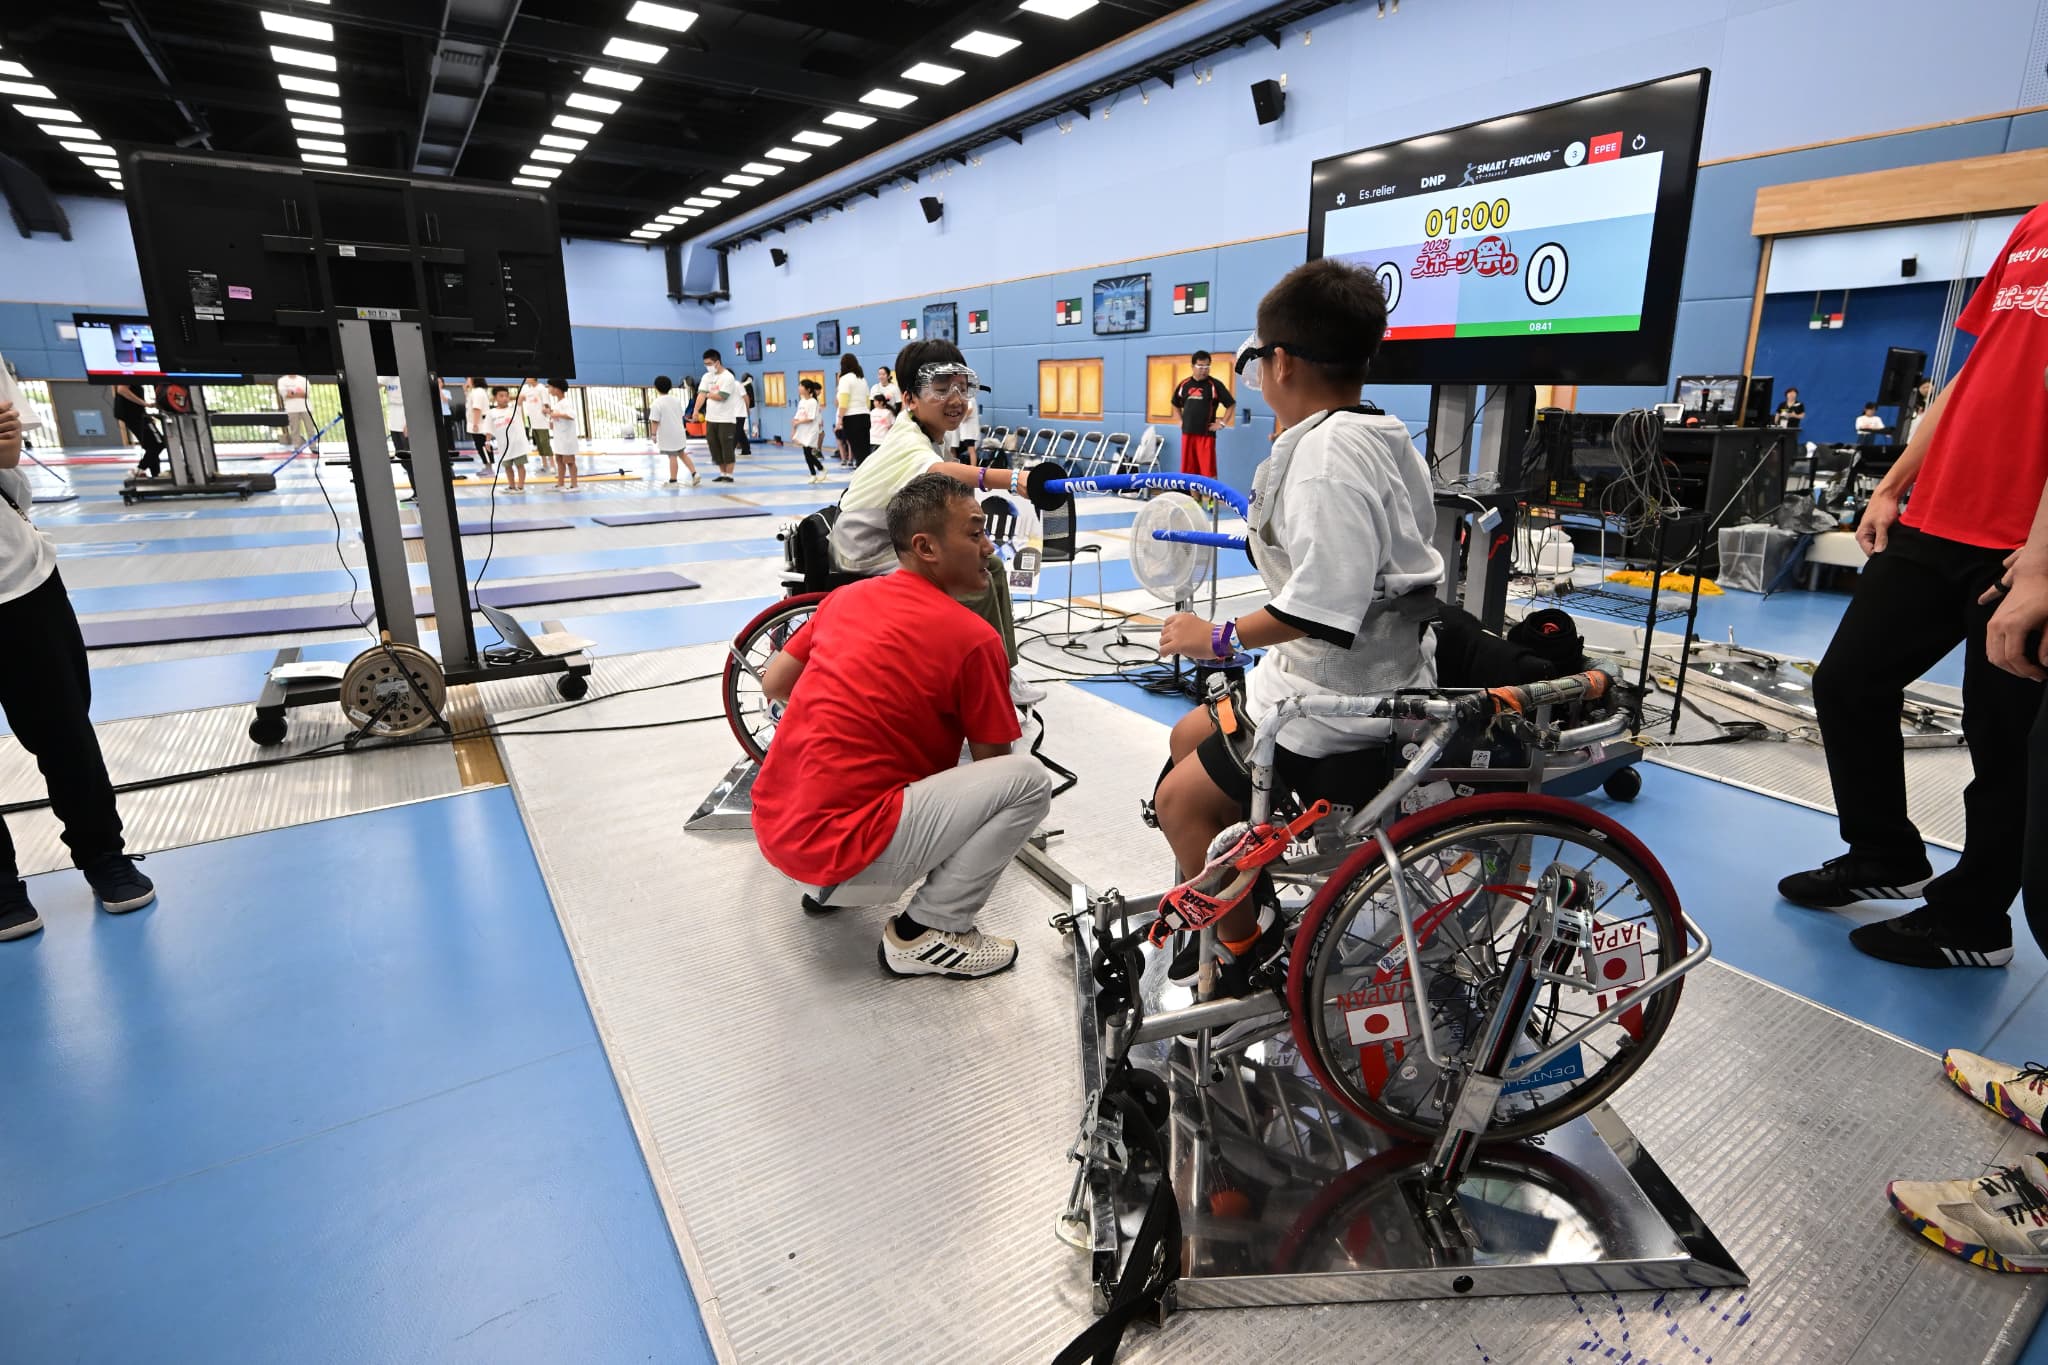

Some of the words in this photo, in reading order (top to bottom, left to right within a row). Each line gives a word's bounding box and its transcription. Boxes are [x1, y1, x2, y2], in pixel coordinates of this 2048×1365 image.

[1572, 150, 1578, 158] 3
[1594, 142, 1616, 155] EPEE
[1476, 159, 1507, 174] SMART
[1509, 150, 1551, 168] FENCING
[1420, 174, 1446, 188] DNP
[1359, 185, 1397, 200] Es.relier
[1425, 198, 1510, 237] 01:00
[1422, 239, 1450, 253] 2025
[1411, 236, 1518, 279] スポーツ祭り
[1525, 242, 1569, 305] 0
[1529, 322, 1552, 331] 0841
[1579, 921, 1647, 957] JAPA
[1336, 981, 1413, 1009] JAPAN
